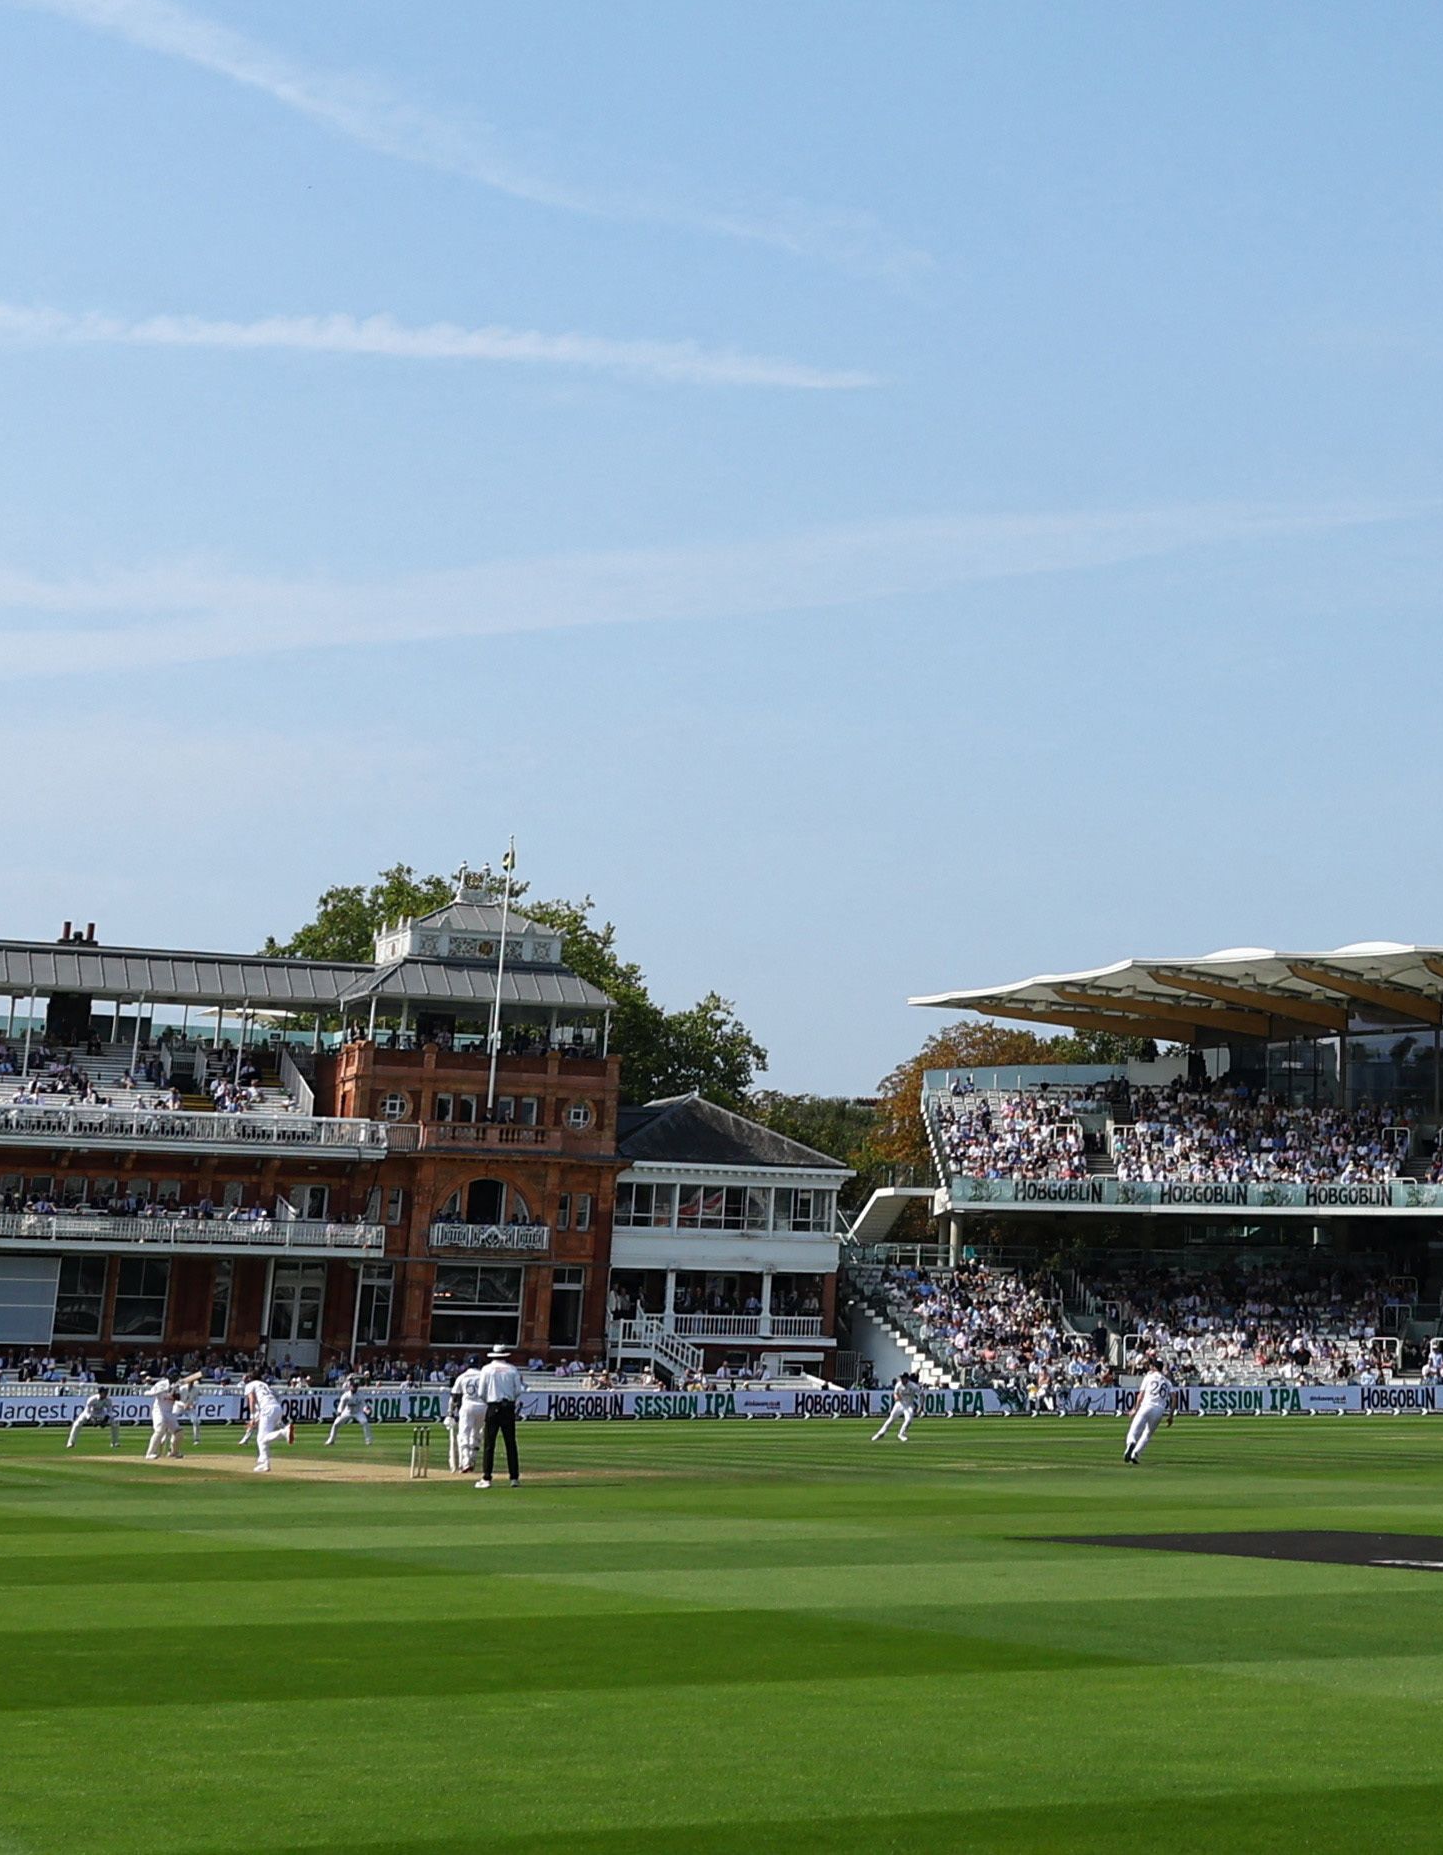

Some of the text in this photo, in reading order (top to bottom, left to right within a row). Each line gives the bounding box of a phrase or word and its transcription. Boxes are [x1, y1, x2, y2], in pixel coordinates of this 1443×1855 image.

[1014, 1180, 1103, 1203] HOBGOBLIN
[1160, 1182, 1247, 1205] HOBGOBLIN
[1305, 1186, 1392, 1206] HOBGOBLIN
[1150, 1380, 1167, 1399] 26
[1200, 1390, 1262, 1409] SESSION
[1270, 1388, 1301, 1410] IPA
[1361, 1387, 1435, 1409] HOBGOBLIN
[408, 1396, 441, 1418] IPA
[547, 1393, 735, 1416] HOBGOBLIN SESSION IPA
[795, 1392, 870, 1415] HOBGOBLIN
[953, 1391, 984, 1412] IPA
